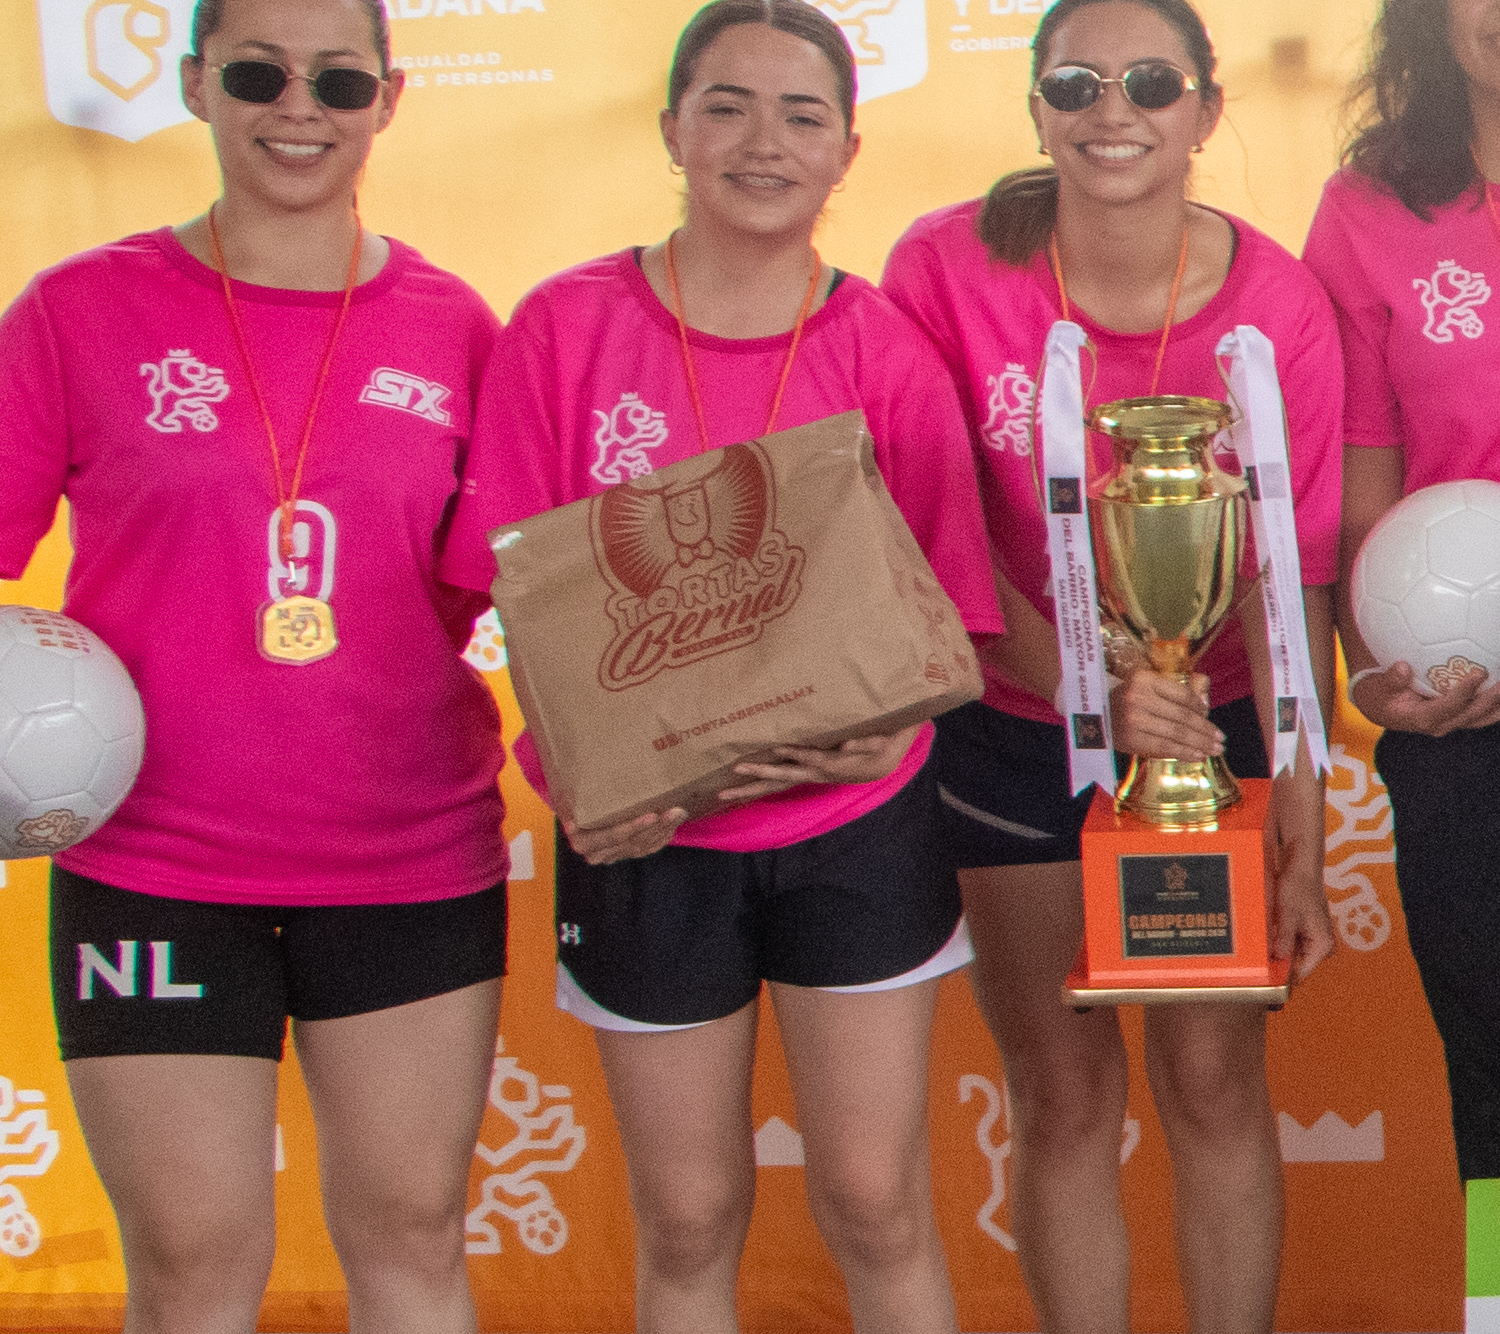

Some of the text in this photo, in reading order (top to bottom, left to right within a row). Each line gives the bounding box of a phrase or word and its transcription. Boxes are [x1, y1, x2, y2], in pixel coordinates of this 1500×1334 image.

[444, 68, 555, 88] PERSONAS
[359, 366, 454, 428] SIX
[268, 499, 337, 601] 9
[616, 539, 784, 629] TORTAS
[608, 555, 797, 682] Bernal
[76, 939, 204, 1002] NL
